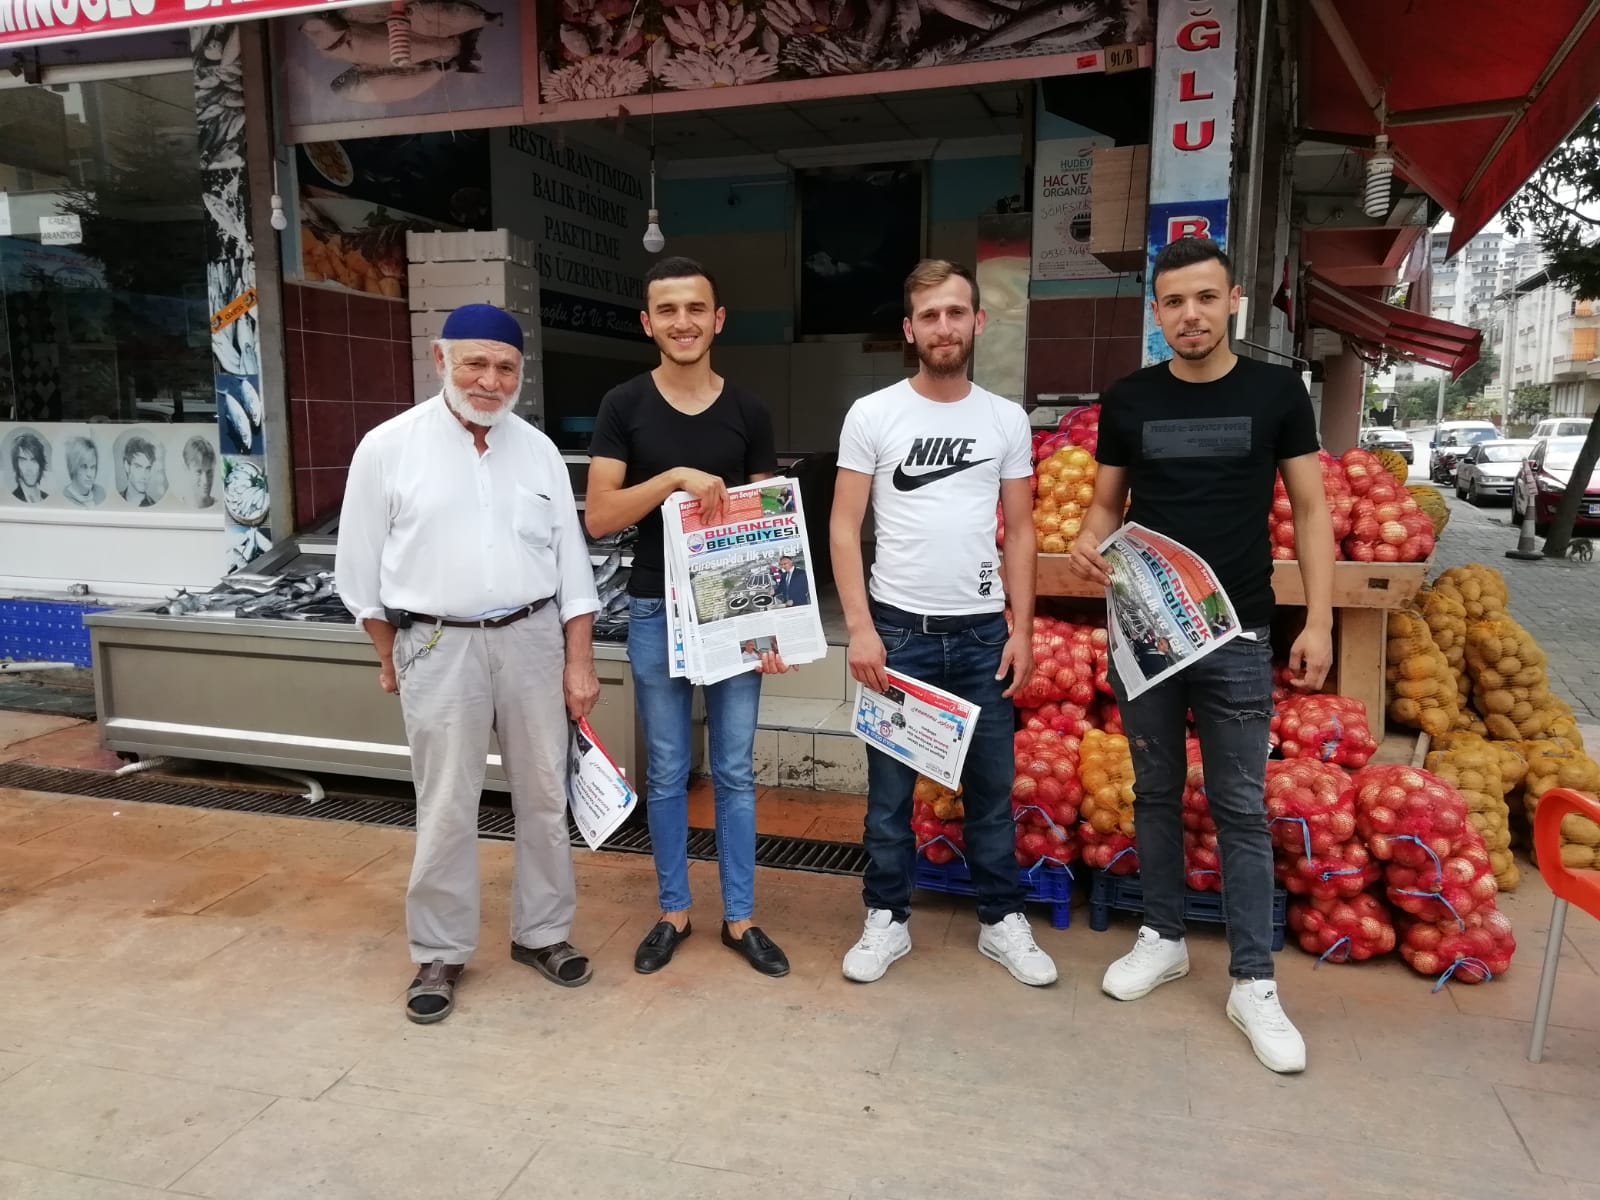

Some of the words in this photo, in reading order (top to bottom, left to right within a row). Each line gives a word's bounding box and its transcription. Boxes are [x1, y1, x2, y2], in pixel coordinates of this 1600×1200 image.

[1110, 48, 1133, 67] 91/B
[1172, 0, 1221, 152] ĞLU
[509, 125, 644, 200] RESTAURANTIMIZDA
[532, 172, 576, 210] BALIK
[1043, 175, 1069, 188] HAC
[1072, 173, 1088, 185] VE
[544, 215, 621, 260] PAKETLEME
[555, 251, 612, 292] ÜZERİNE
[904, 437, 977, 467] NIKE
[705, 516, 796, 540] BULANCAK
[706, 524, 800, 550] BELEDİYESİ
[763, 550, 775, 559] ve
[979, 570, 993, 581] 97
[1141, 550, 1206, 649] BELEDİYESİ
[1146, 545, 1211, 642] BULANCAK
